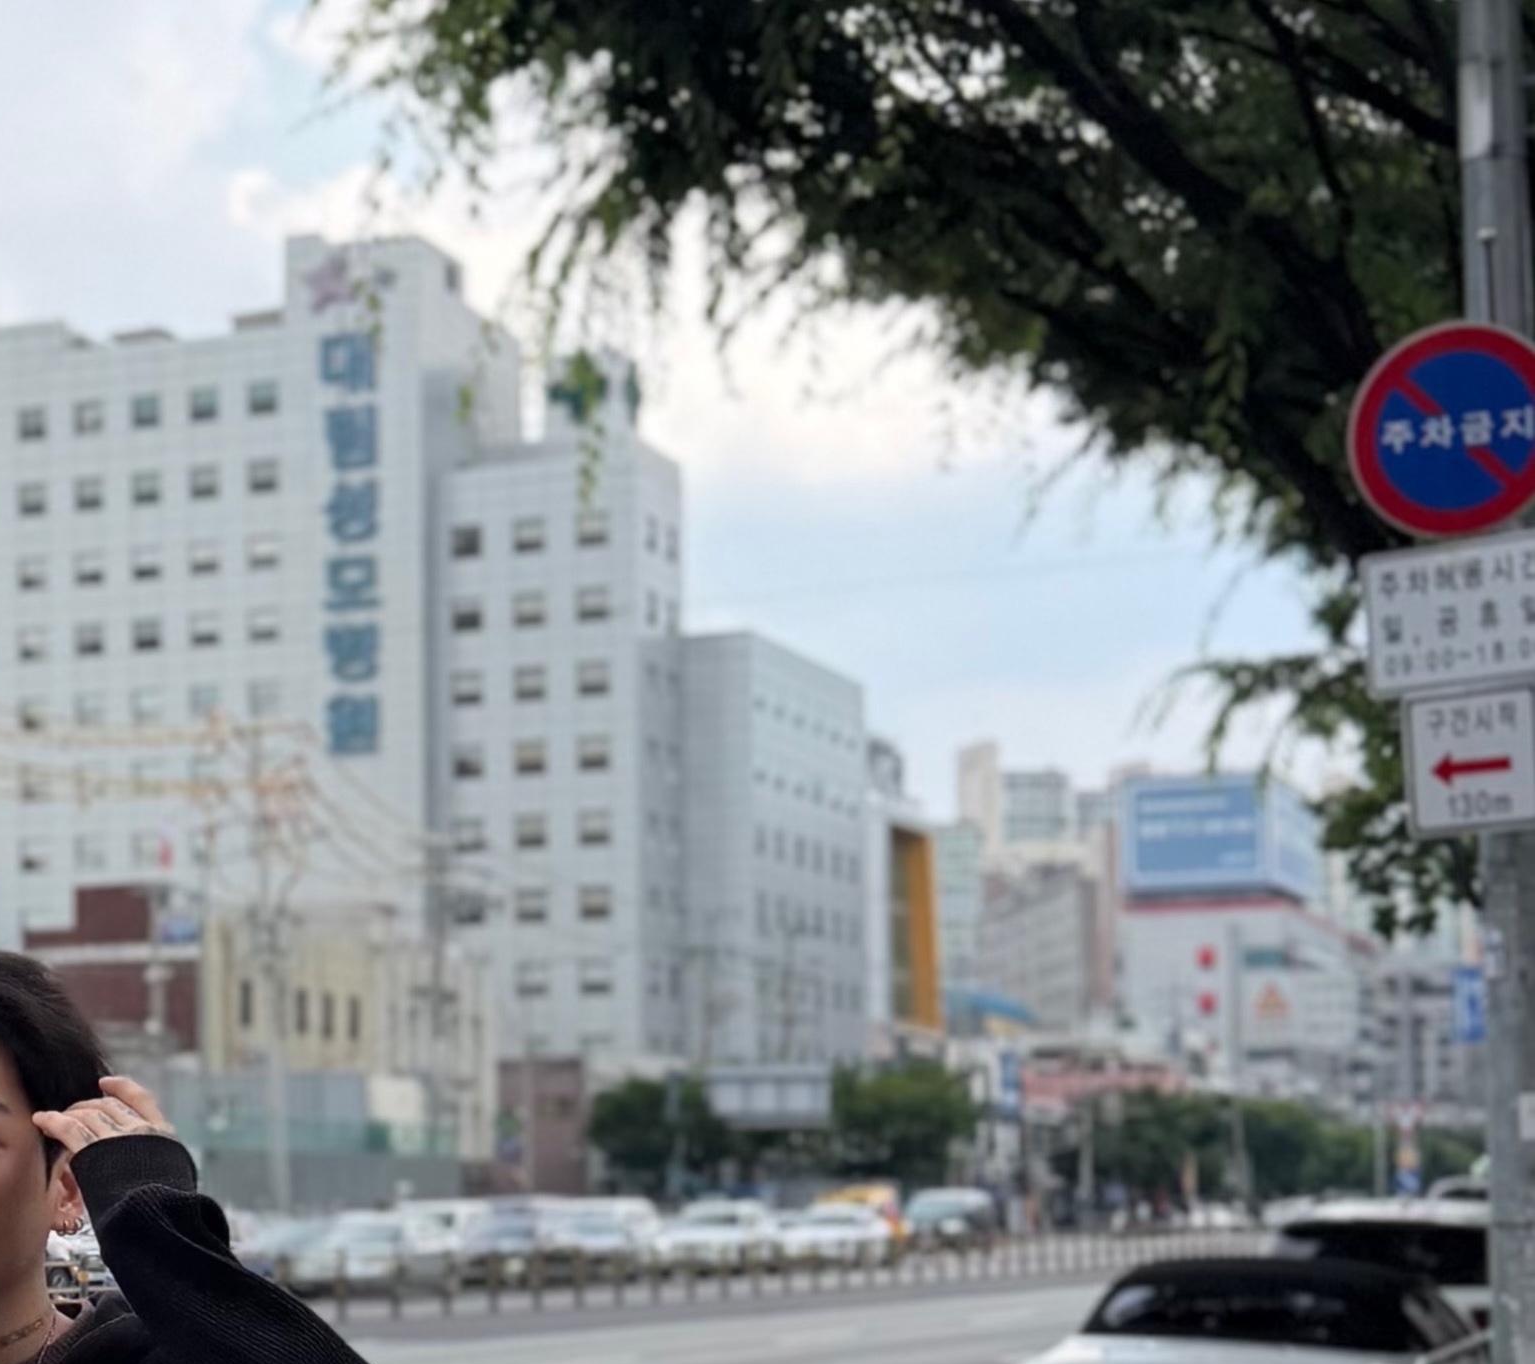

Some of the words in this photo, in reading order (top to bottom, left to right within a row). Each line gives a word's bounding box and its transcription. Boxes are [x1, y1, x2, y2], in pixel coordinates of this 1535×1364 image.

[1380, 404, 1534, 456] 주차금지
[1427, 701, 1517, 739] 구간시작
[1447, 789, 1513, 818] 130m
